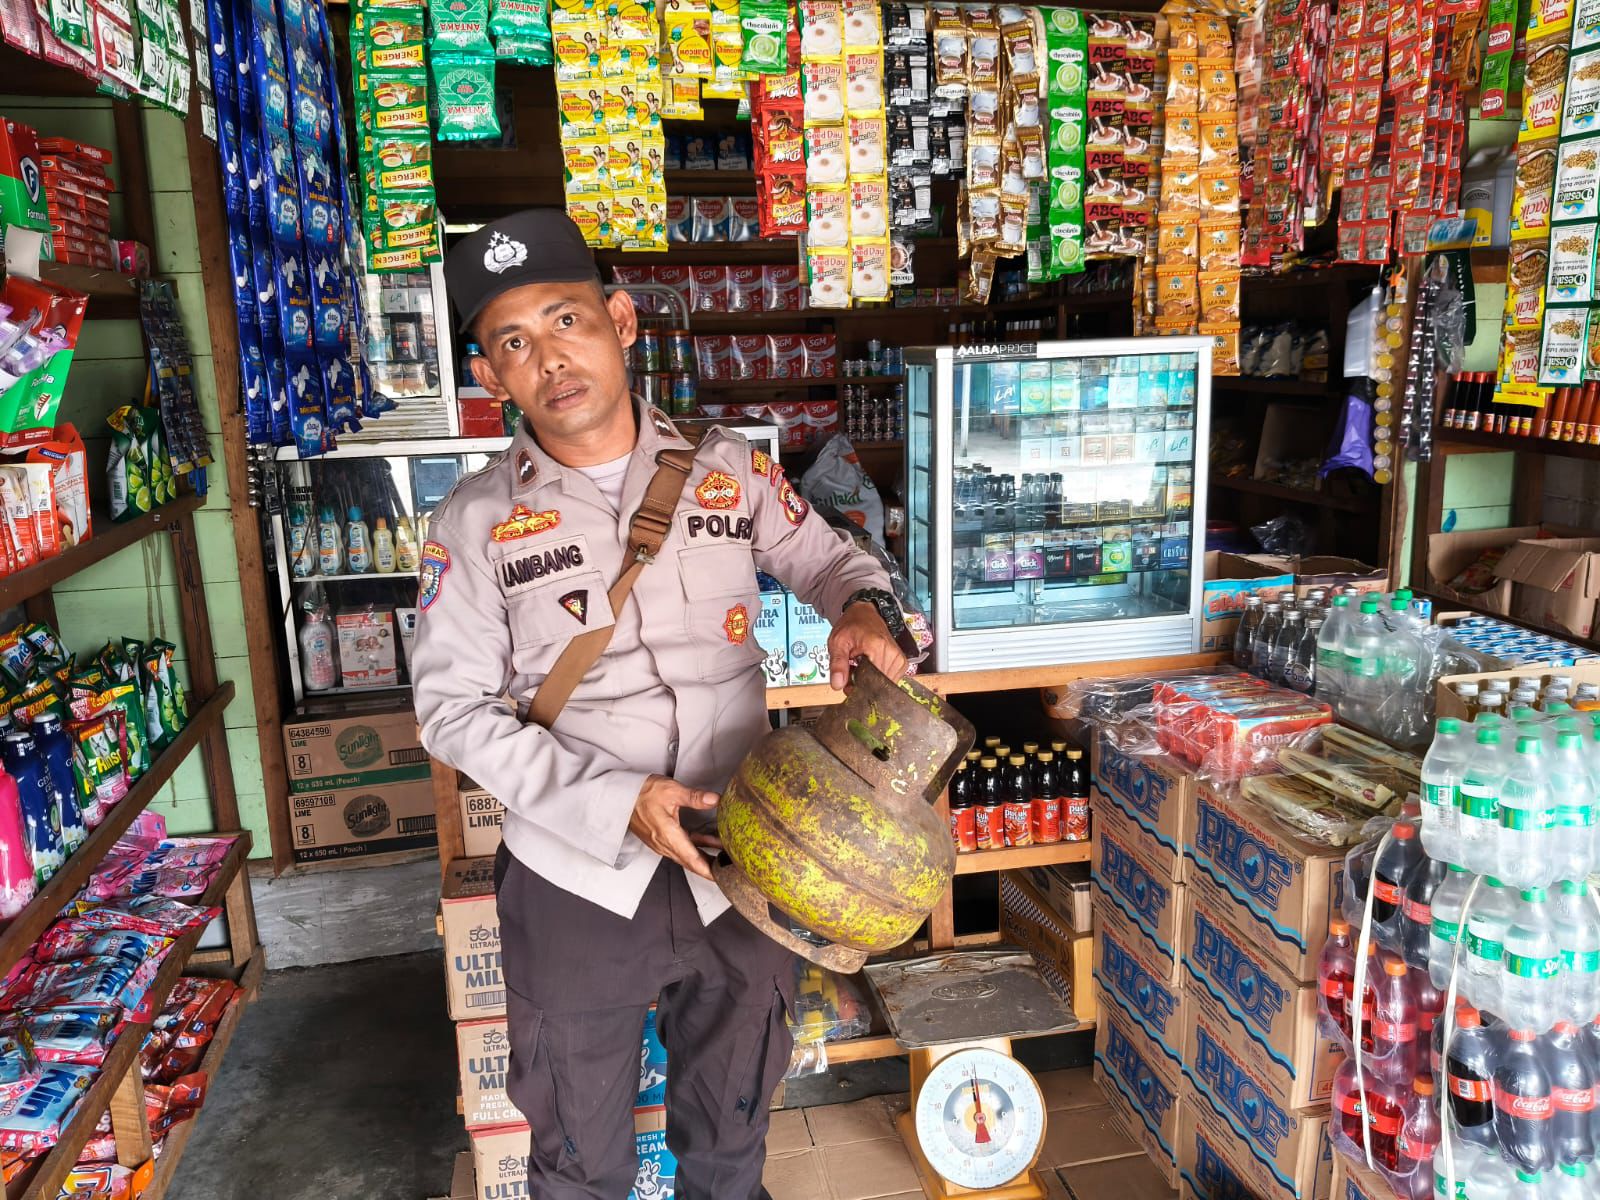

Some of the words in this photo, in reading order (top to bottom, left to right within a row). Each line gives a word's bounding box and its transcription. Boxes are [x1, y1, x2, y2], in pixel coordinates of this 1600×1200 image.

[500, 1, 541, 13] ANTAKA
[821, 2, 837, 11] Day
[439, 23, 480, 32] ANTAKA
[375, 49, 420, 62] ENERGEN
[558, 46, 586, 55] Dancow
[679, 48, 710, 58] Dancow
[1093, 46, 1124, 58] ABC
[861, 58, 878, 66] Day
[825, 66, 841, 76] Day
[447, 103, 487, 115] ANTAKA
[563, 103, 591, 111] Dancow
[1092, 101, 1124, 113] ABC
[1529, 94, 1562, 119] Racik
[379, 110, 424, 123] ENERGEN
[864, 121, 880, 131] Day
[827, 131, 843, 140] Day
[568, 159, 596, 168] Dancow
[1091, 153, 1122, 165] ABC
[384, 170, 428, 183] ENERGEN
[867, 185, 883, 194] Day
[1558, 187, 1595, 202] Desaku
[829, 195, 845, 204] Day
[1089, 205, 1120, 216] ABC
[1520, 197, 1550, 219] Racik
[572, 215, 598, 225] Dancow
[391, 226, 431, 242] ENERGEN
[869, 247, 885, 257] Day
[375, 251, 417, 265] ENERGEN
[831, 257, 846, 267] Day
[622, 269, 642, 280] SGM
[661, 268, 680, 280] SGM
[698, 269, 717, 280] SGM
[735, 268, 753, 280] SGM
[771, 268, 790, 279] SGM
[1515, 295, 1540, 316] Racik
[703, 338, 721, 349] SGM
[738, 338, 757, 349] SGM
[775, 337, 792, 348] SGM
[809, 337, 827, 347] SGM
[776, 405, 794, 415] SGM
[811, 404, 829, 415] SGM
[502, 544, 584, 588] LAMBANG
[795, 606, 820, 616] ULT
[1252, 731, 1291, 745] Roma
[340, 732, 380, 761] Sunlight
[298, 756, 306, 769] 8
[347, 803, 387, 830] Sunlight
[469, 814, 503, 828] LIME
[301, 826, 310, 839] 8
[466, 970, 503, 988] MIL
[469, 1056, 506, 1073] ULT
[1512, 1097, 1549, 1113] Coca-Cola
[473, 1111, 499, 1121] FULL
[636, 1133, 658, 1142] RESH
